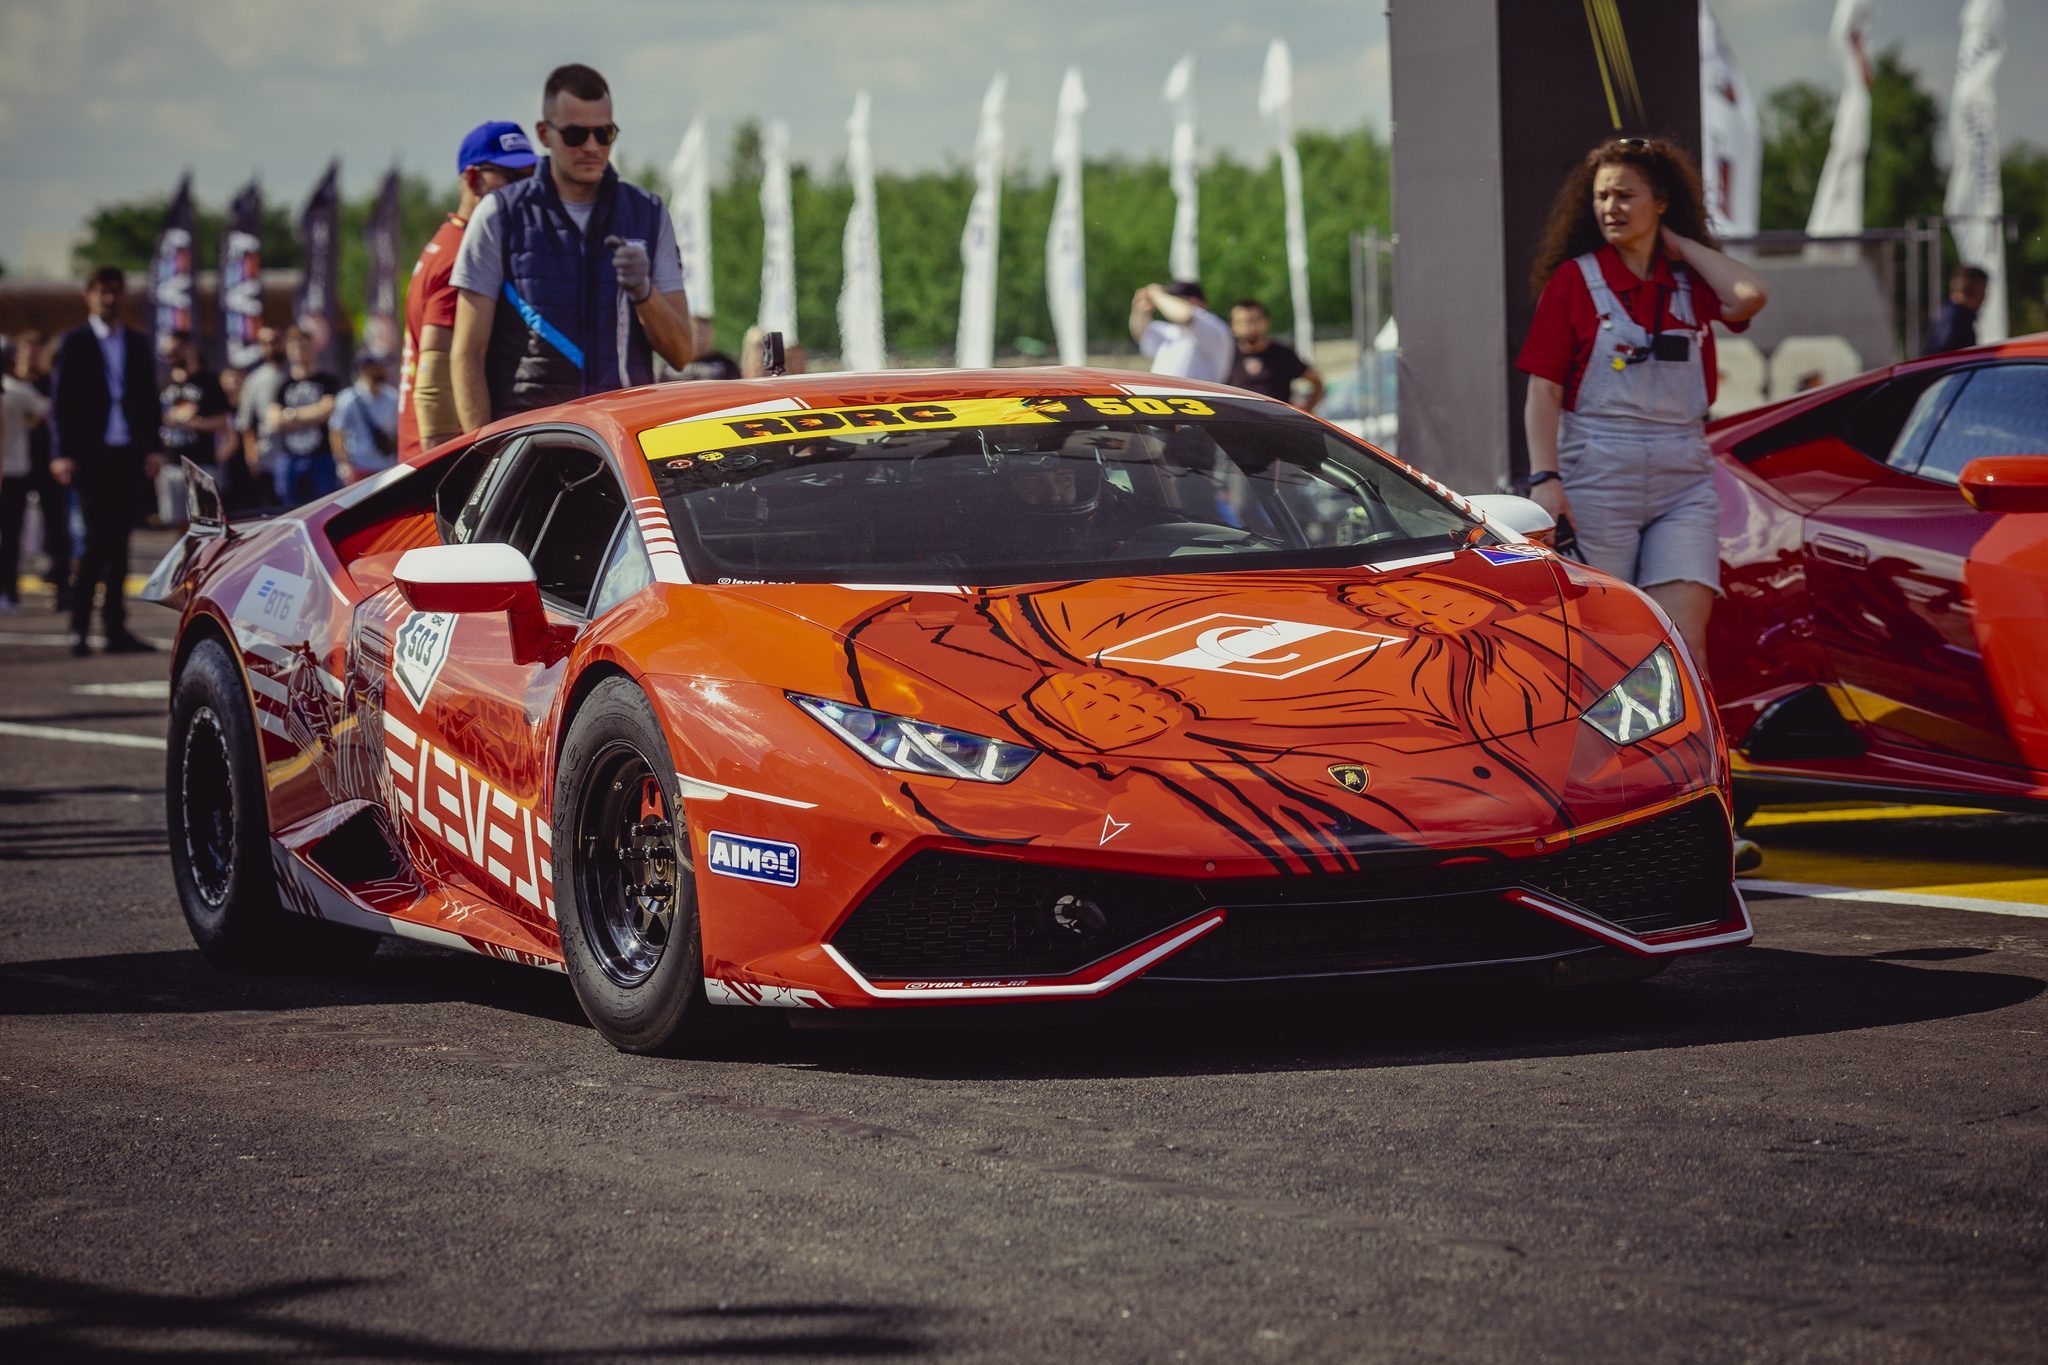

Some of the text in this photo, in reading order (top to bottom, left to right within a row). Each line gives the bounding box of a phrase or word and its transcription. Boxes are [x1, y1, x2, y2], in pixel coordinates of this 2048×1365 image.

[722, 397, 1216, 439] RDRC 503
[263, 588, 294, 620] ВТБ
[408, 623, 439, 667] 503
